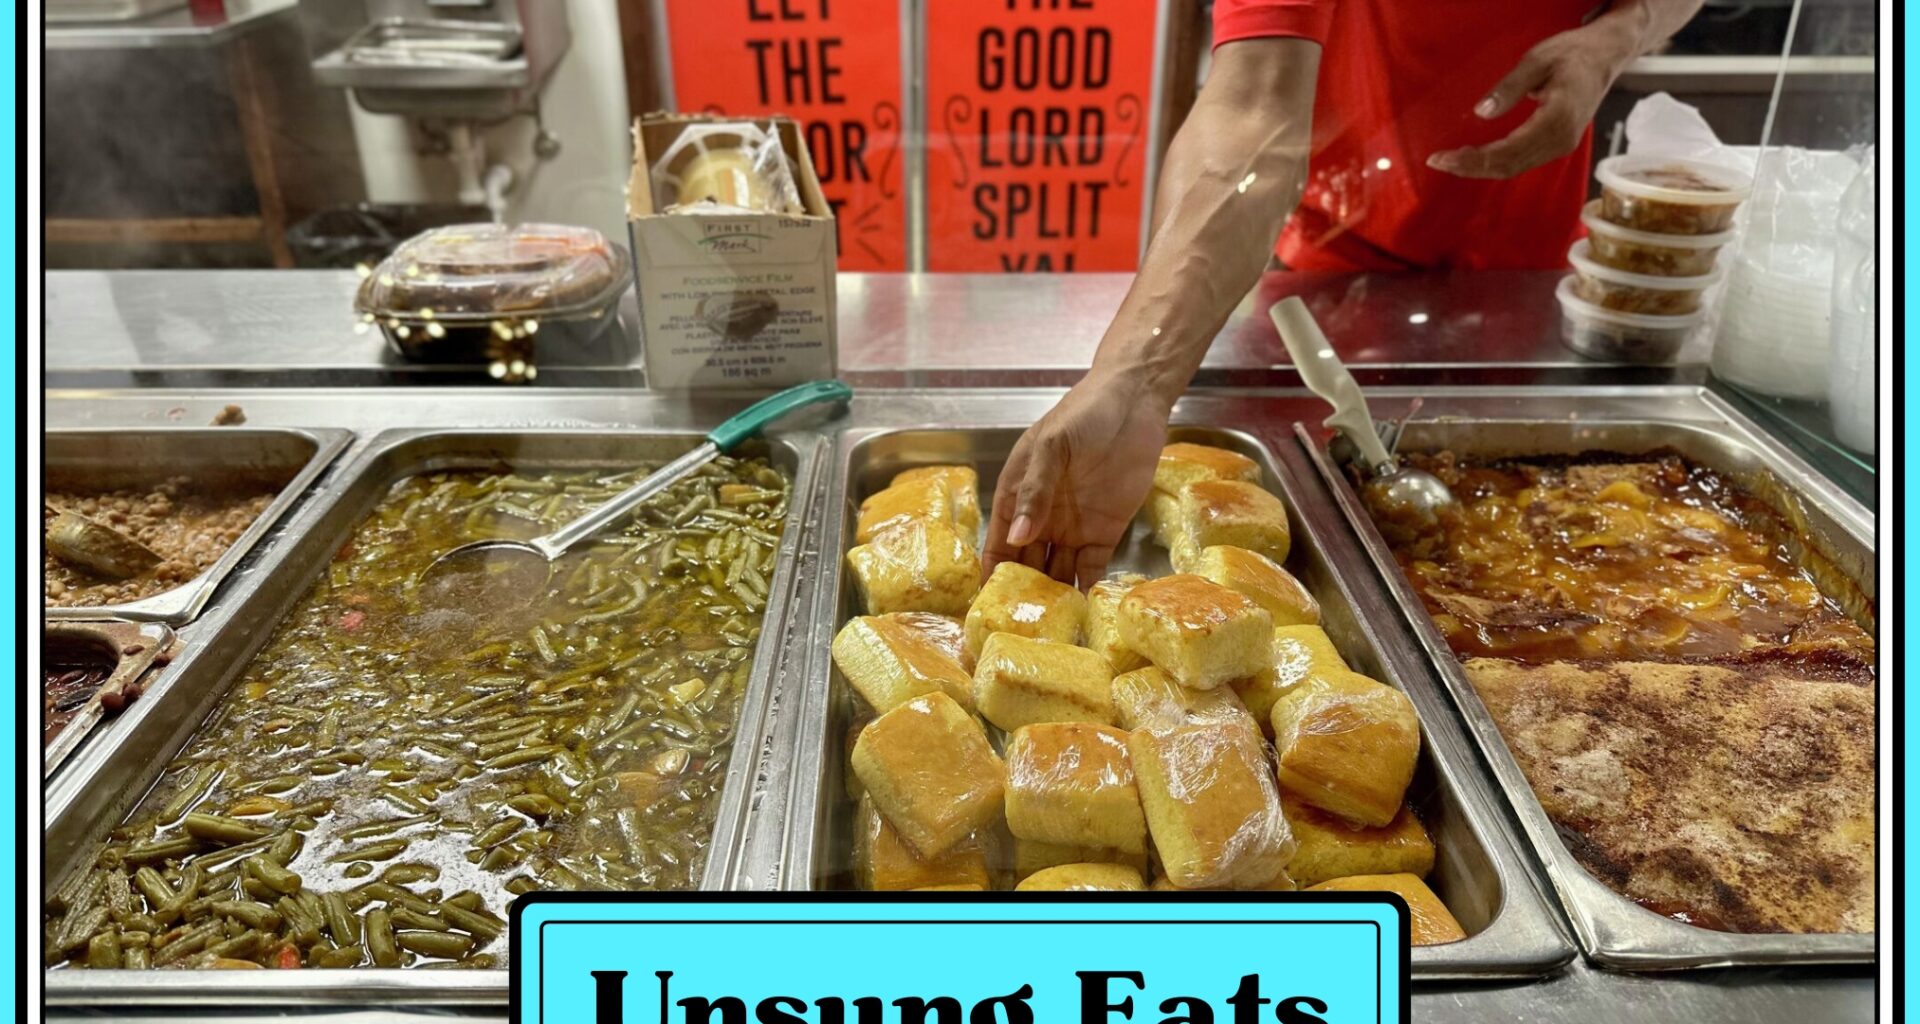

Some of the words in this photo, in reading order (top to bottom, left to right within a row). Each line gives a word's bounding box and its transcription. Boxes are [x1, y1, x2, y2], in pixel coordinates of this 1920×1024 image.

[746, 37, 846, 106] THE
[978, 27, 1112, 91] GOOD
[807, 120, 871, 184] OR
[980, 106, 1105, 169] LORD
[707, 223, 751, 233] FIRST
[973, 181, 1109, 240] SPLIT
[790, 286, 816, 295] EDGE
